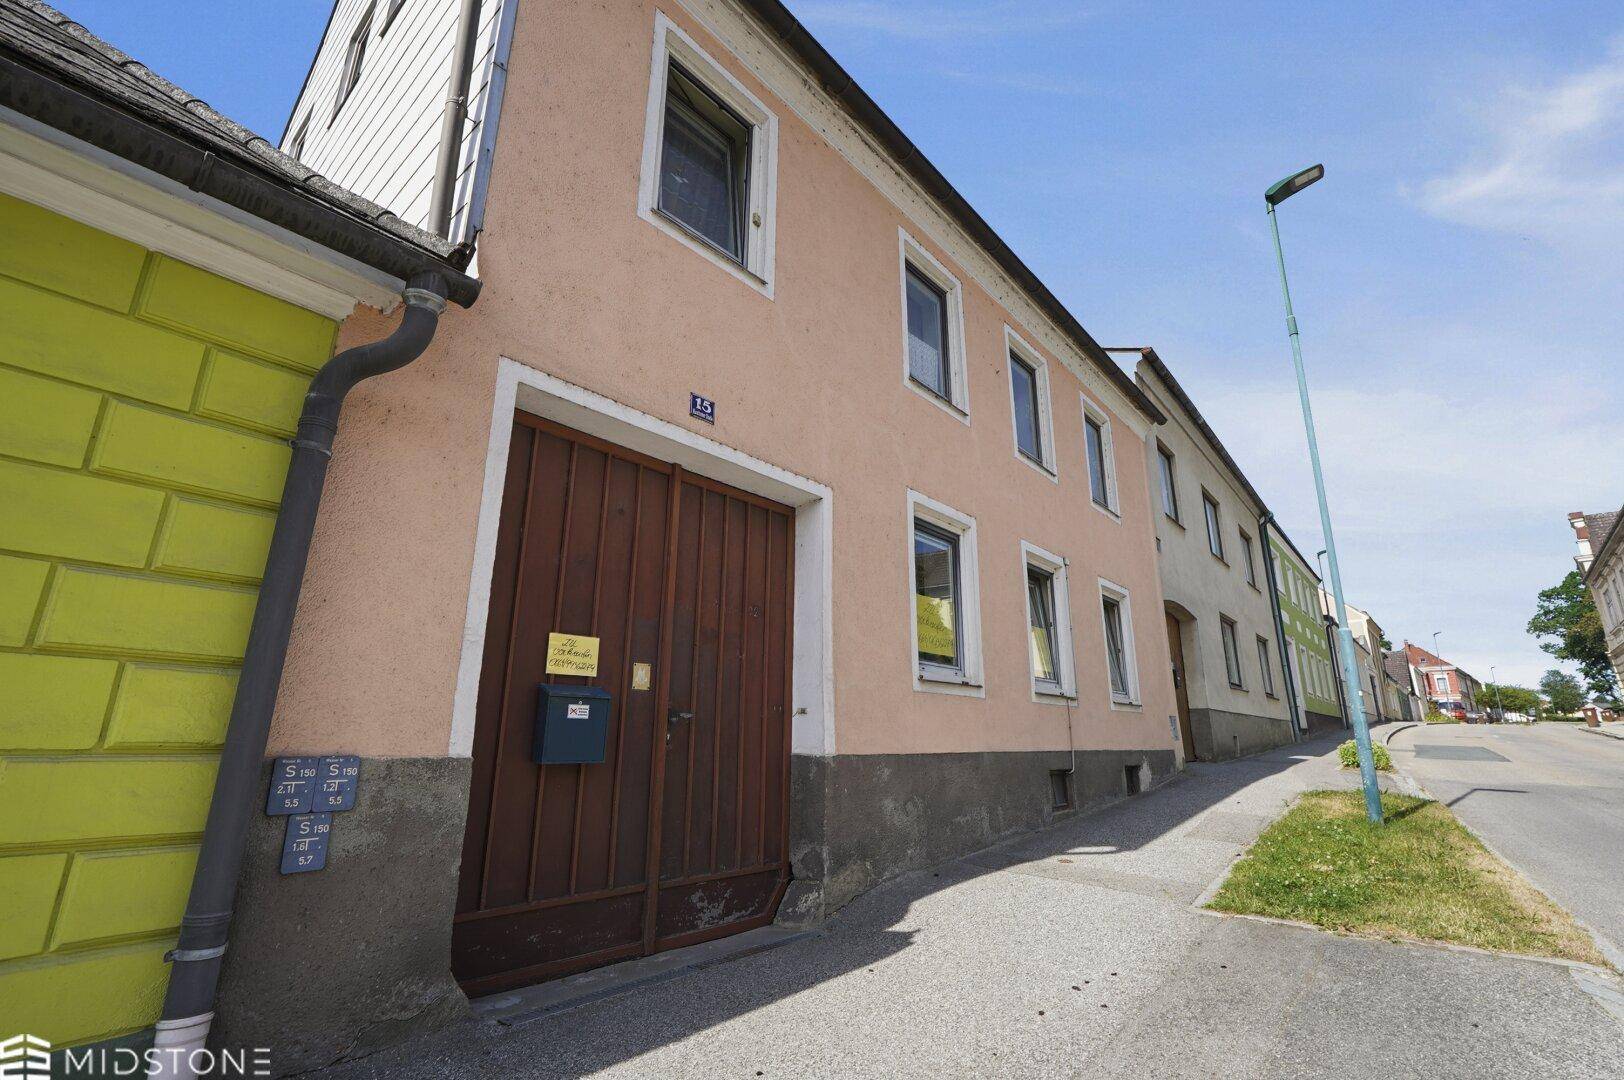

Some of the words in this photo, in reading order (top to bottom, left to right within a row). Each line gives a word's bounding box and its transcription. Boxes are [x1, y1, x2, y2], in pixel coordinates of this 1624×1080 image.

[695, 397, 711, 413] 15
[285, 765, 297, 777] S
[300, 768, 316, 777] 150
[329, 764, 340, 776] S
[343, 767, 358, 776] 150
[299, 821, 311, 834] S
[313, 824, 330, 834] 150
